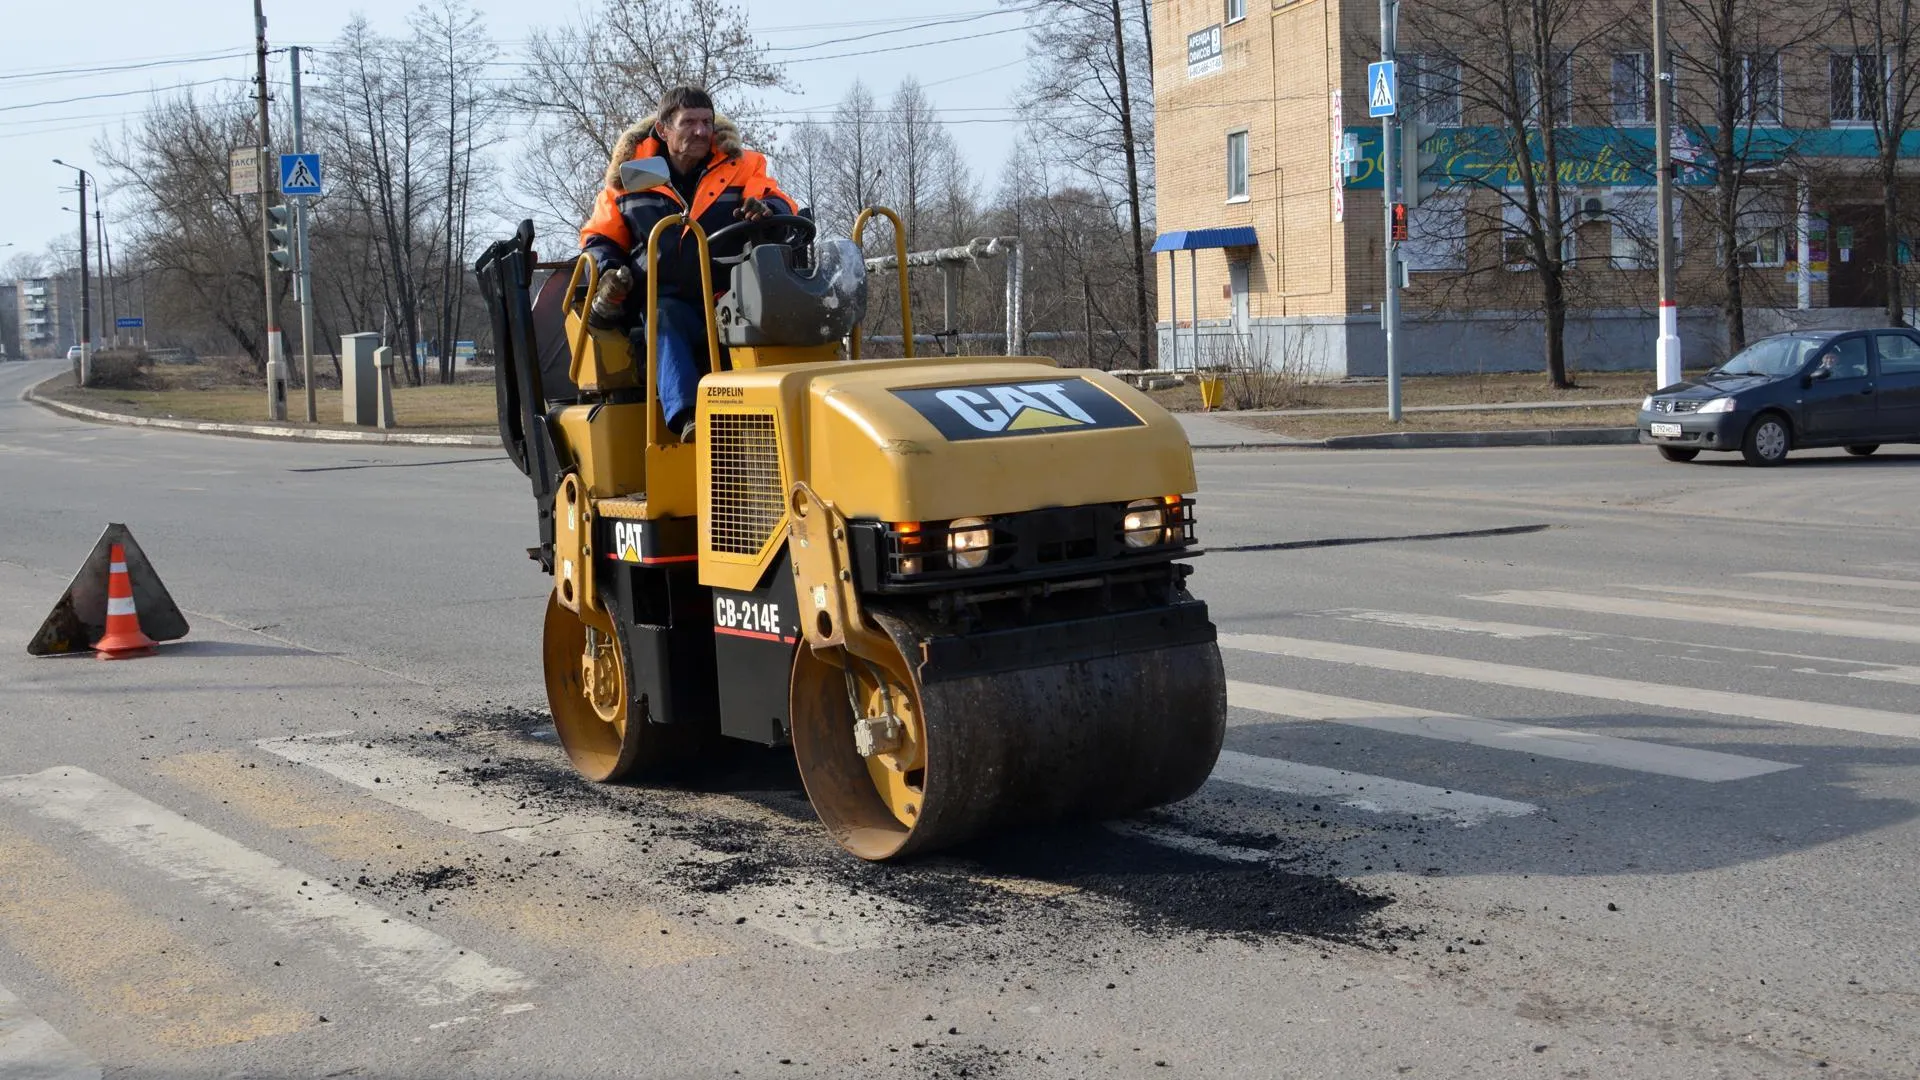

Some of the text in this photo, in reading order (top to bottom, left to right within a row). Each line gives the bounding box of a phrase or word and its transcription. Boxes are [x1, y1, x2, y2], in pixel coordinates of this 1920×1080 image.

[1189, 31, 1211, 48] АРЕНДА
[1189, 46, 1211, 63] ОФИСОВ
[1334, 95, 1342, 216] АПТЕКА
[707, 387, 744, 397] ZEPPELIN
[935, 383, 1097, 432] CAT
[615, 521, 643, 563] CAT
[716, 597, 781, 634] CB-214E
